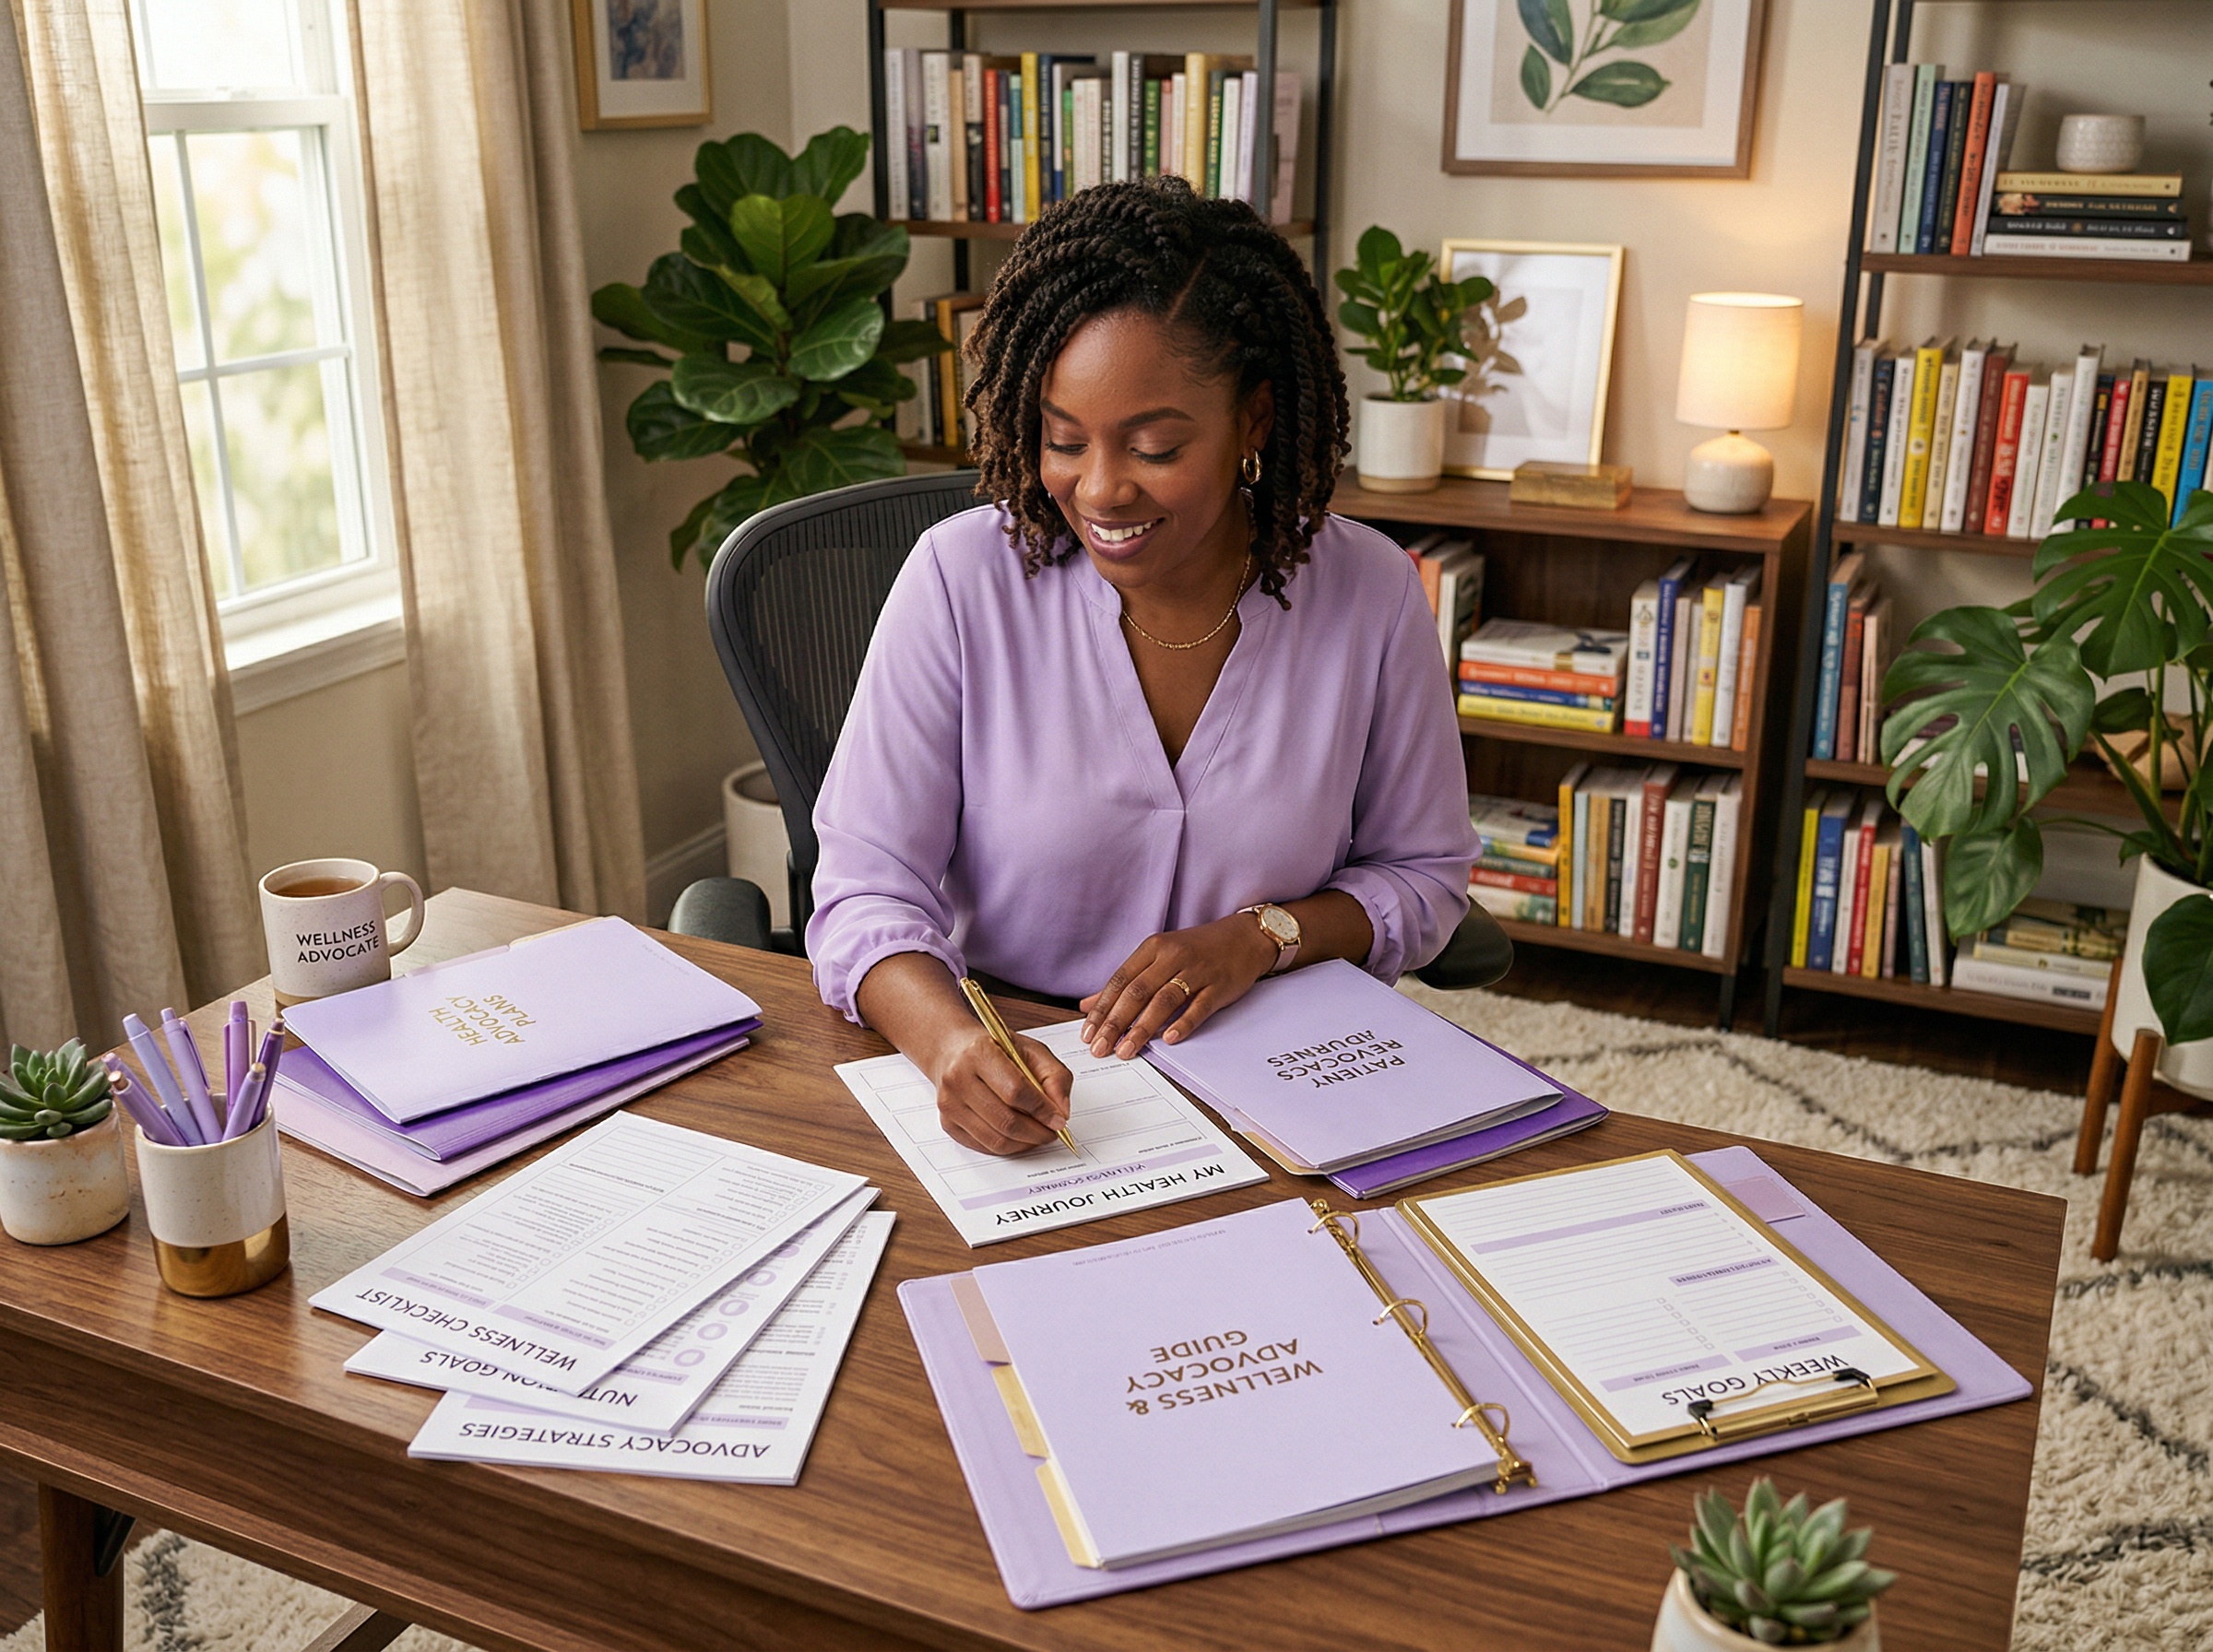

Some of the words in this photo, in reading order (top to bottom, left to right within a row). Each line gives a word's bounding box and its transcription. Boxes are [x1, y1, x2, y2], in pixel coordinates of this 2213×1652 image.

[296, 920, 376, 947] WELLNESS
[297, 935, 380, 963] ADVOCATE
[427, 1007, 489, 1046] HEALTH
[444, 996, 527, 1044] ADVOCACY
[482, 995, 537, 1027] PLANS
[1276, 1039, 1404, 1080] REVOCACS
[1101, 1173, 1188, 1201] HEALTH
[1193, 1162, 1225, 1181] MY
[995, 1194, 1095, 1225] JOURNEY
[355, 1288, 469, 1333] CHECKLIST
[468, 1326, 578, 1372] WELLNESS
[1150, 1330, 1249, 1363] GUIDE
[419, 1351, 499, 1377] GOALS
[1127, 1338, 1298, 1394] ADVOCACY
[1753, 1354, 1851, 1386] WEEKLY
[1157, 1360, 1324, 1410] WELLNESS
[1662, 1376, 1746, 1406] GOALS
[1125, 1398, 1150, 1416] &
[458, 1422, 615, 1448] STRATEGIES
[619, 1436, 771, 1458] ADVOCACY
